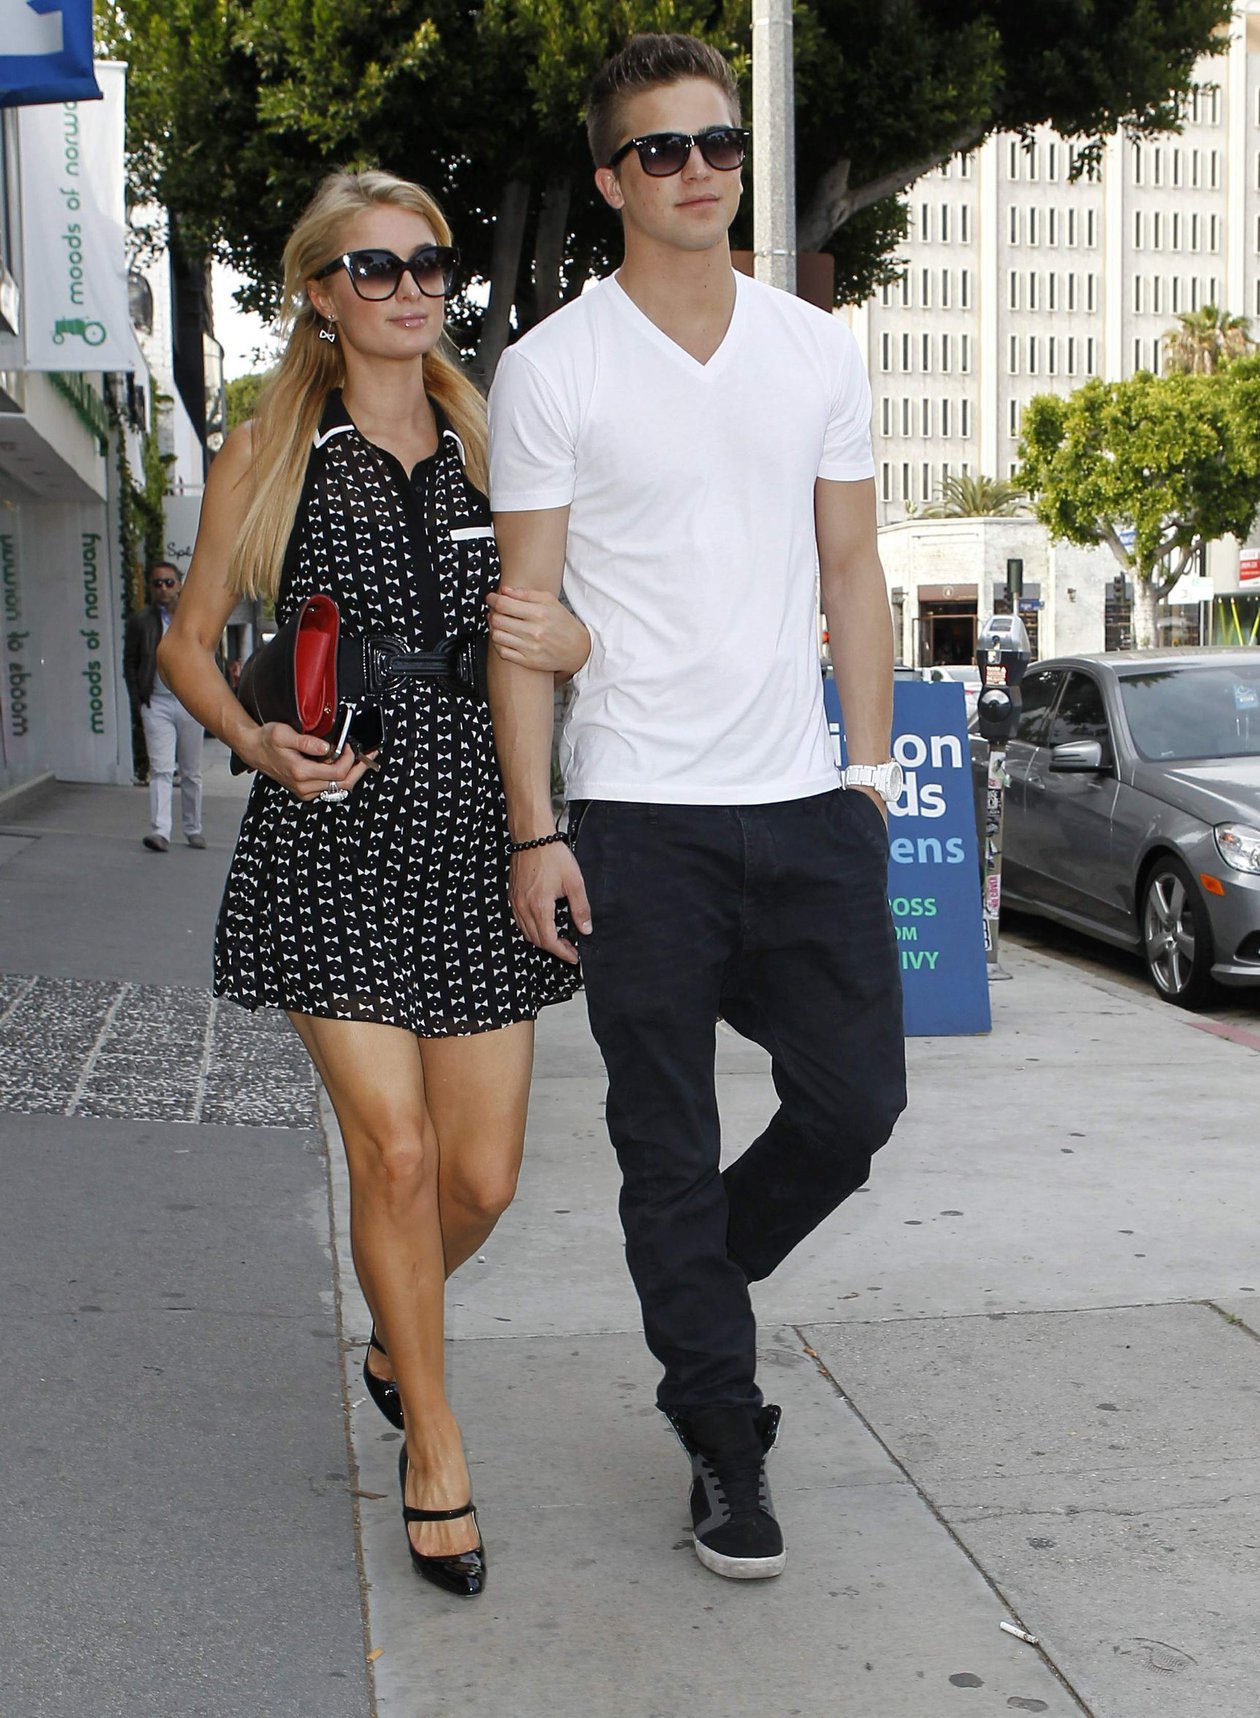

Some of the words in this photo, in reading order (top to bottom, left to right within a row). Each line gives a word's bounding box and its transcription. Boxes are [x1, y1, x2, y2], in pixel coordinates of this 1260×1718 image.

[64, 101, 79, 176] norwa
[59, 187, 80, 211] of
[61, 223, 84, 305] moods
[82, 533, 102, 619] norway
[80, 629, 100, 650] of
[81, 660, 104, 735] moods
[886, 772, 946, 818] ds
[890, 837, 965, 864] ens
[889, 897, 937, 916] OSS
[902, 951, 939, 970] IVY
